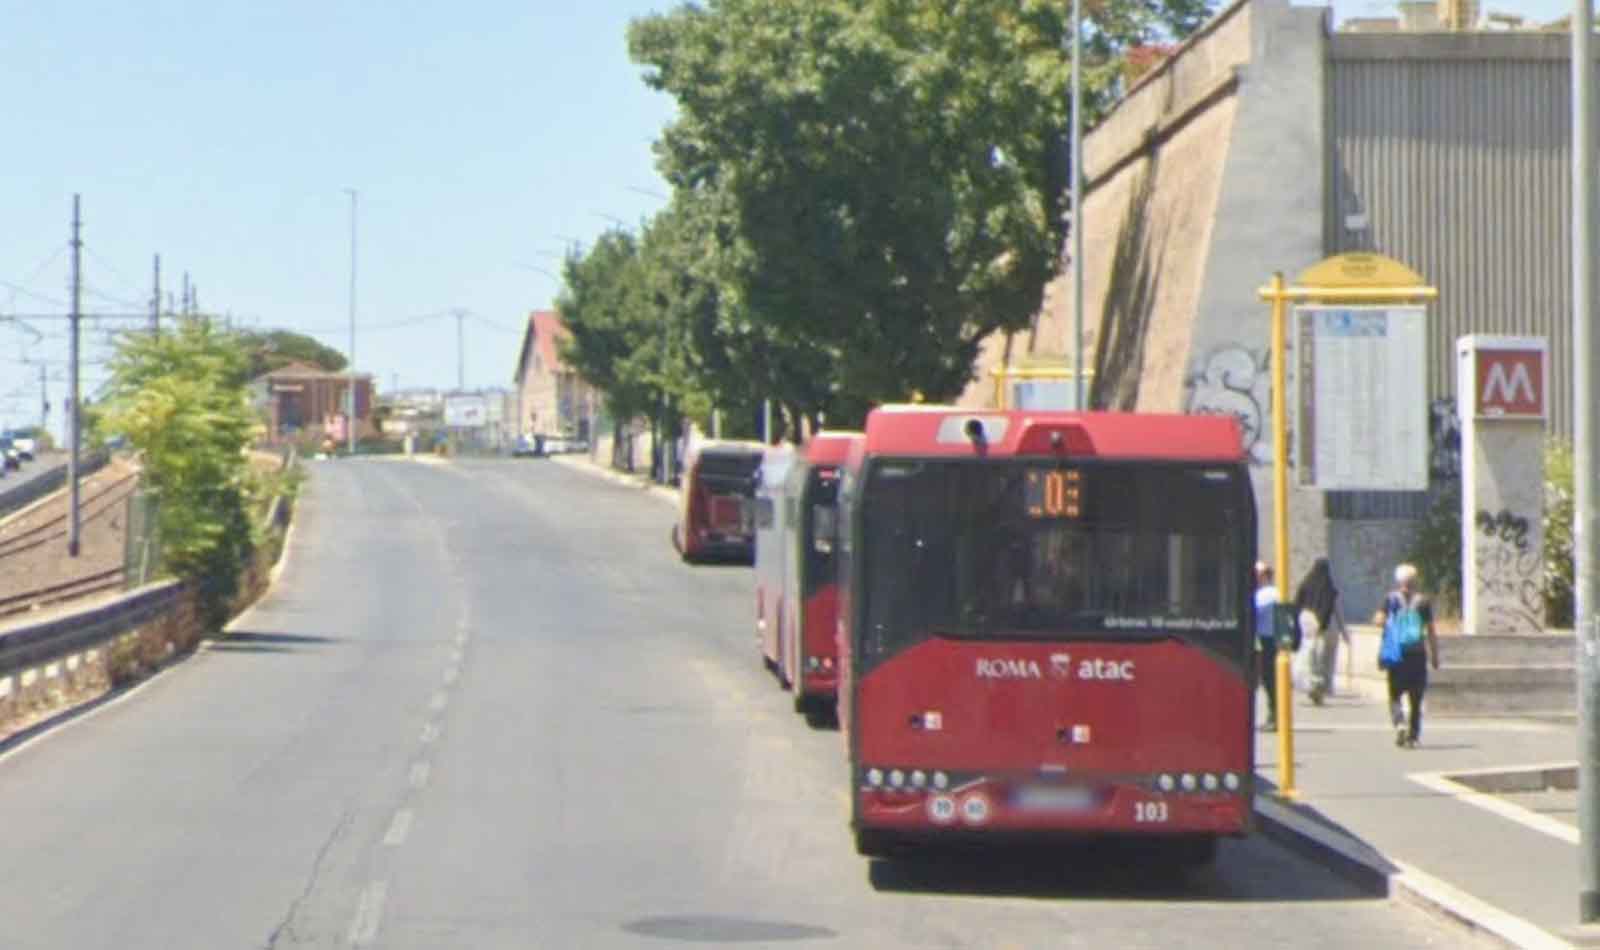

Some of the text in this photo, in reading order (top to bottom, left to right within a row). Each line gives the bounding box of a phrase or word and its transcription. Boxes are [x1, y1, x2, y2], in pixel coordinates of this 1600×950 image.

[1482, 361, 1536, 403] M
[975, 658, 1136, 680] ROMA atac
[1135, 801, 1169, 823] 103
